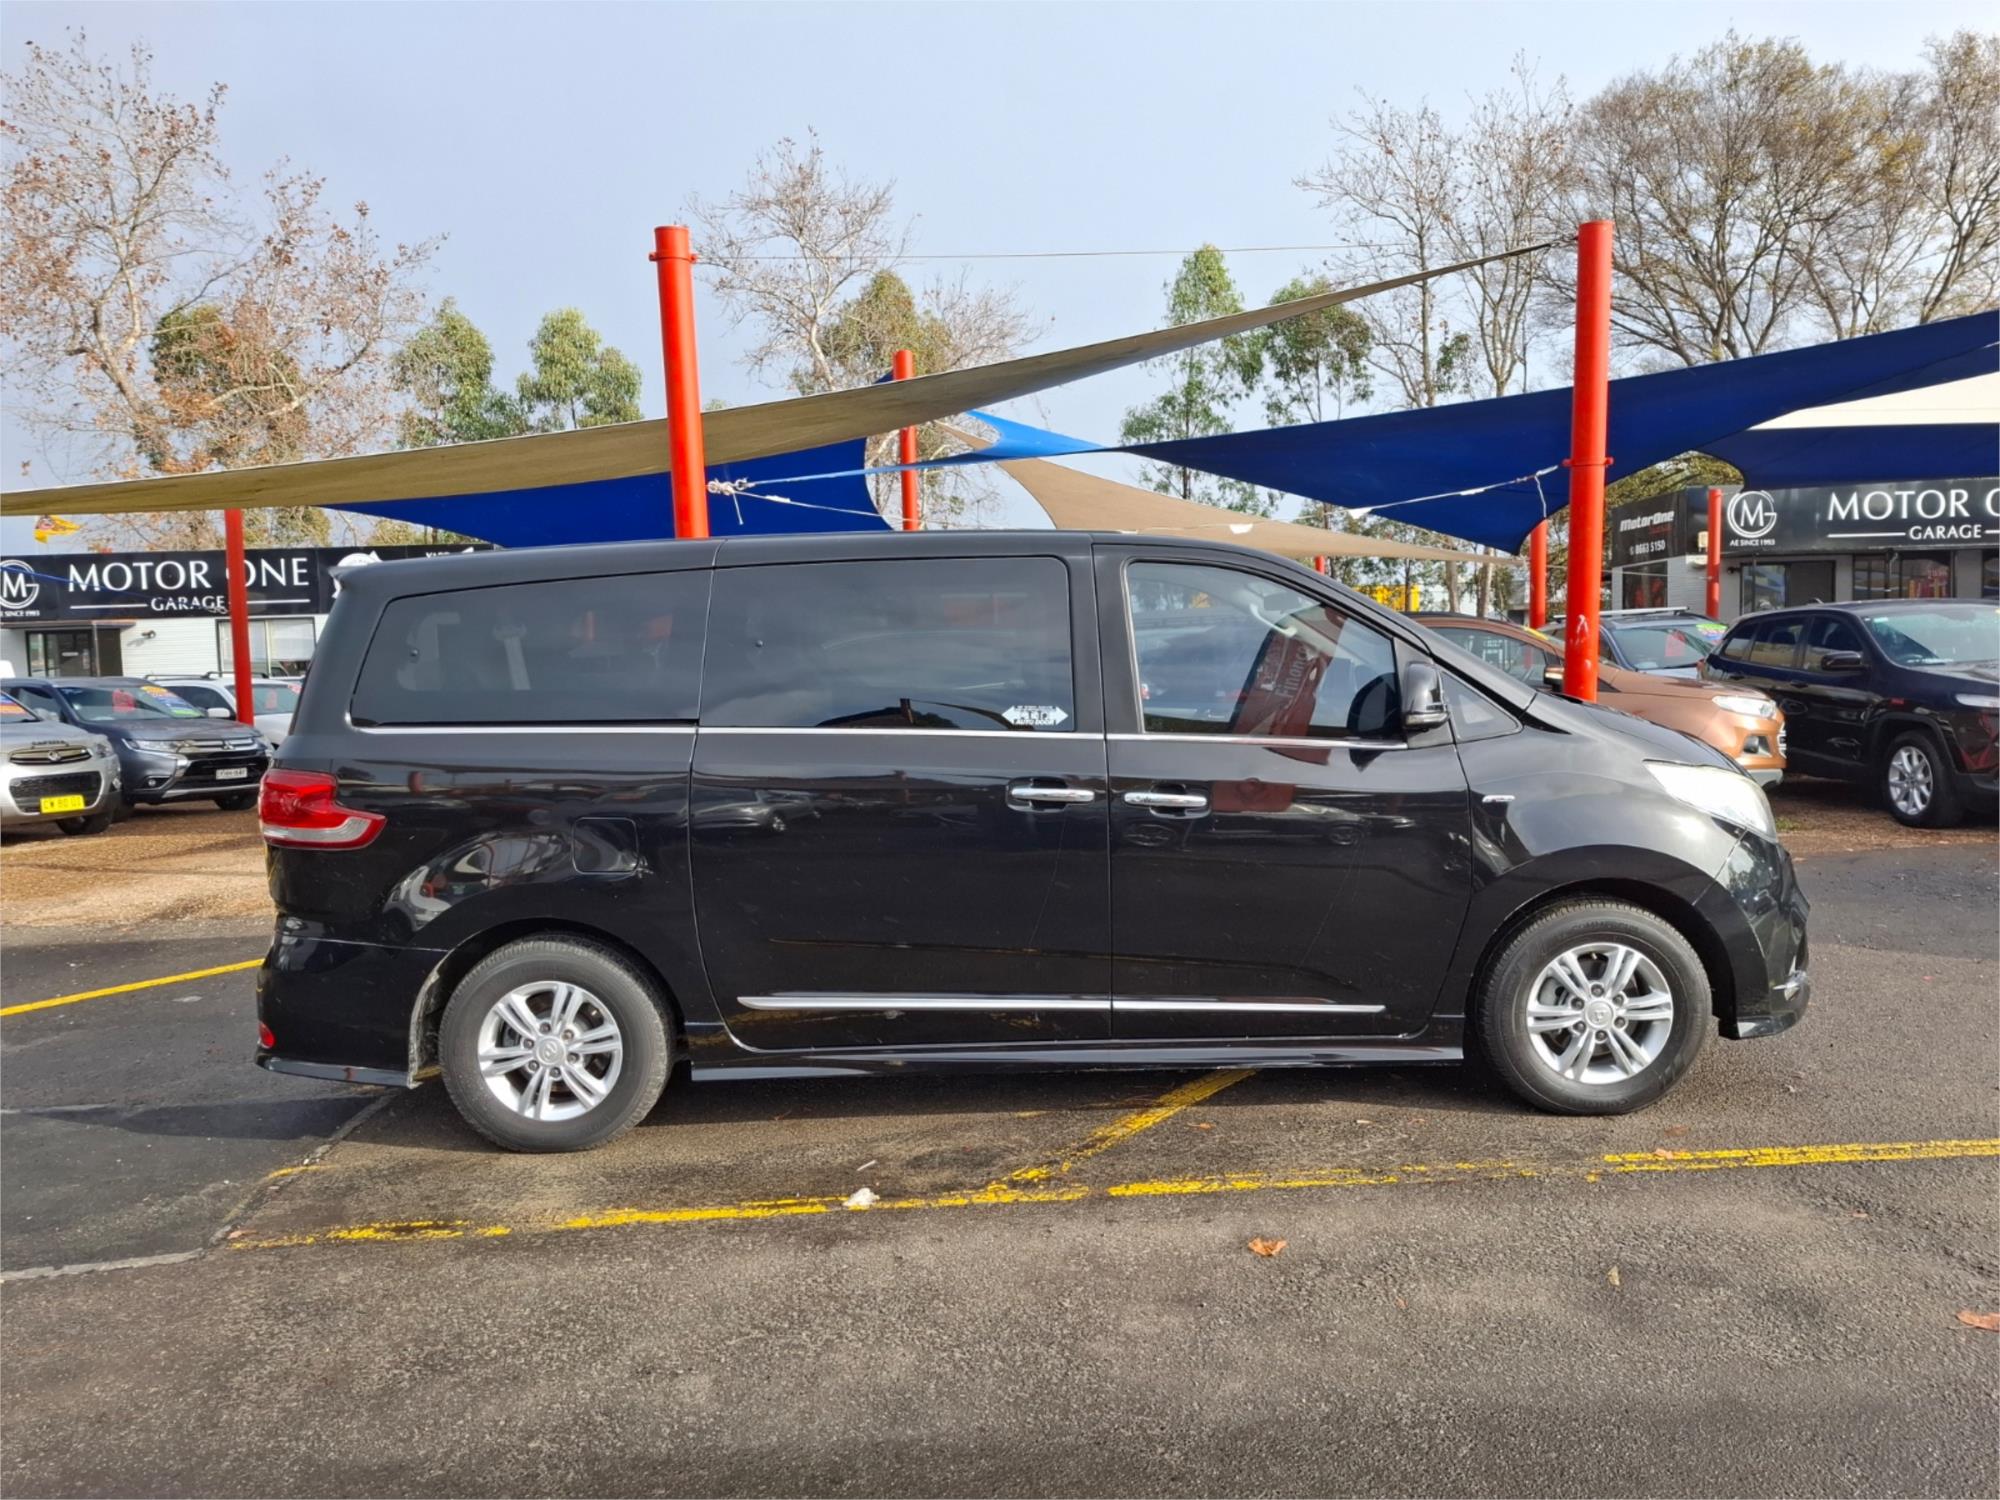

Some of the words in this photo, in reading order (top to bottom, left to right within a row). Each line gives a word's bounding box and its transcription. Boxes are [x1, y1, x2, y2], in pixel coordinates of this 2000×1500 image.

[1827, 488, 1970, 520] MOTOR
[1909, 524, 1982, 540] GARAGE
[68, 560, 212, 592] MOTOR
[151, 595, 225, 612] GARAGE
